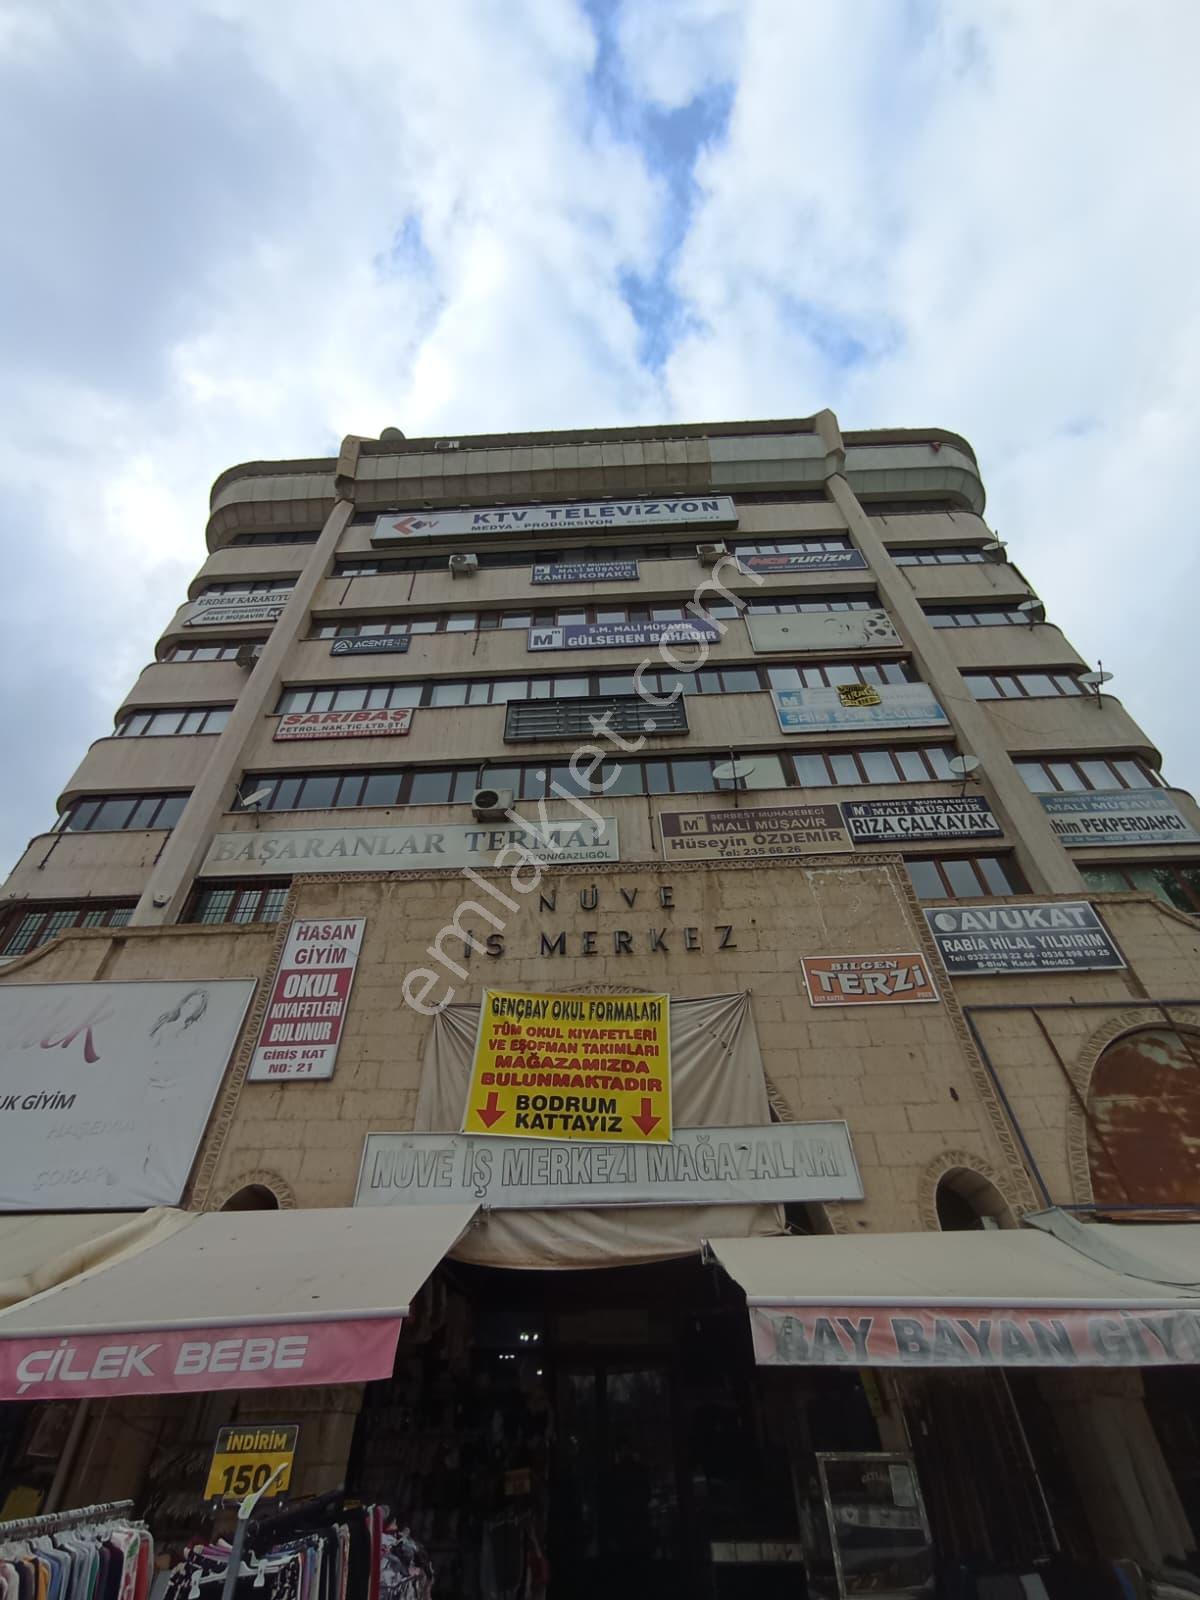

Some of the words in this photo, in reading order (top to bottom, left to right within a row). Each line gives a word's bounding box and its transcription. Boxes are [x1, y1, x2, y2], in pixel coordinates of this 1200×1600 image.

[471, 522, 514, 532] MEDYA
[473, 511, 528, 525] KTV
[789, 553, 852, 565] TURİZM
[198, 597, 235, 606] ERDEM
[567, 633, 646, 647] GÜLSEREN
[650, 630, 717, 643] BAHADIR
[614, 623, 642, 633] MALİ
[283, 710, 410, 725] SARIBAŞ
[709, 812, 756, 821] SERBEST
[871, 806, 910, 816] MALİ
[914, 802, 983, 815] MÜŞAVİR
[711, 820, 752, 833] MALİ
[754, 816, 828, 832] MÜŞAVİR
[851, 818, 894, 835] RIZA
[897, 813, 995, 836] ÇALKAYAK
[213, 832, 446, 866] BAŞARANLAR
[465, 824, 610, 853] TERMAL
[671, 836, 748, 851] Hüseyin
[753, 828, 843, 846] ÖZDEMİR
[718, 849, 740, 857] Tel:
[743, 847, 766, 856] 235
[787, 845, 802, 854] 26
[538, 884, 676, 913] NÜVE
[960, 907, 1088, 931] AVUKAT
[296, 924, 357, 941] HASAN
[540, 925, 738, 956] MERKEZ
[941, 935, 988, 953] RABİA
[990, 934, 1036, 951] HİLAL
[1036, 933, 1107, 949] YILDIRIM
[294, 944, 347, 965] GİYİM
[283, 973, 340, 999] OKUL
[810, 963, 926, 997] TERZİ
[270, 997, 344, 1019] KIYAFETLERİ
[492, 997, 550, 1023] GENÇBAY
[552, 1000, 586, 1021] OKUL
[590, 1001, 662, 1023] FORMALARI
[268, 1021, 332, 1042] BULUNUR
[493, 1023, 521, 1037] TÜM
[525, 1026, 565, 1039] OKUL
[567, 1026, 658, 1041] KIYAFETLERİ
[263, 1049, 298, 1062] GİRİŞ
[301, 1049, 327, 1059] KAT
[489, 1039, 506, 1051] VE
[510, 1040, 578, 1055] EŞOFMAN
[582, 1042, 660, 1057] TAKIMLARI
[268, 1063, 292, 1074] NO:
[296, 1062, 313, 1073] 21
[494, 1052, 650, 1075] MAĞAZAMIZDA
[480, 1072, 663, 1093] BULUNMAKTADIR
[21, 1090, 78, 1112] GİYİM
[515, 1094, 617, 1115] BODRUM
[515, 1112, 623, 1133] KATTAYIZ
[371, 1139, 456, 1189] NÜVE
[461, 1140, 493, 1198] İŞ
[647, 1134, 849, 1183] MAĞAZALARI
[772, 1316, 873, 1364] BAY
[890, 1316, 1078, 1364] BAYAN
[16, 1338, 164, 1395] ÇİLEK
[173, 1335, 309, 1376] BEBE
[226, 1430, 288, 1452] İNDİRİM
